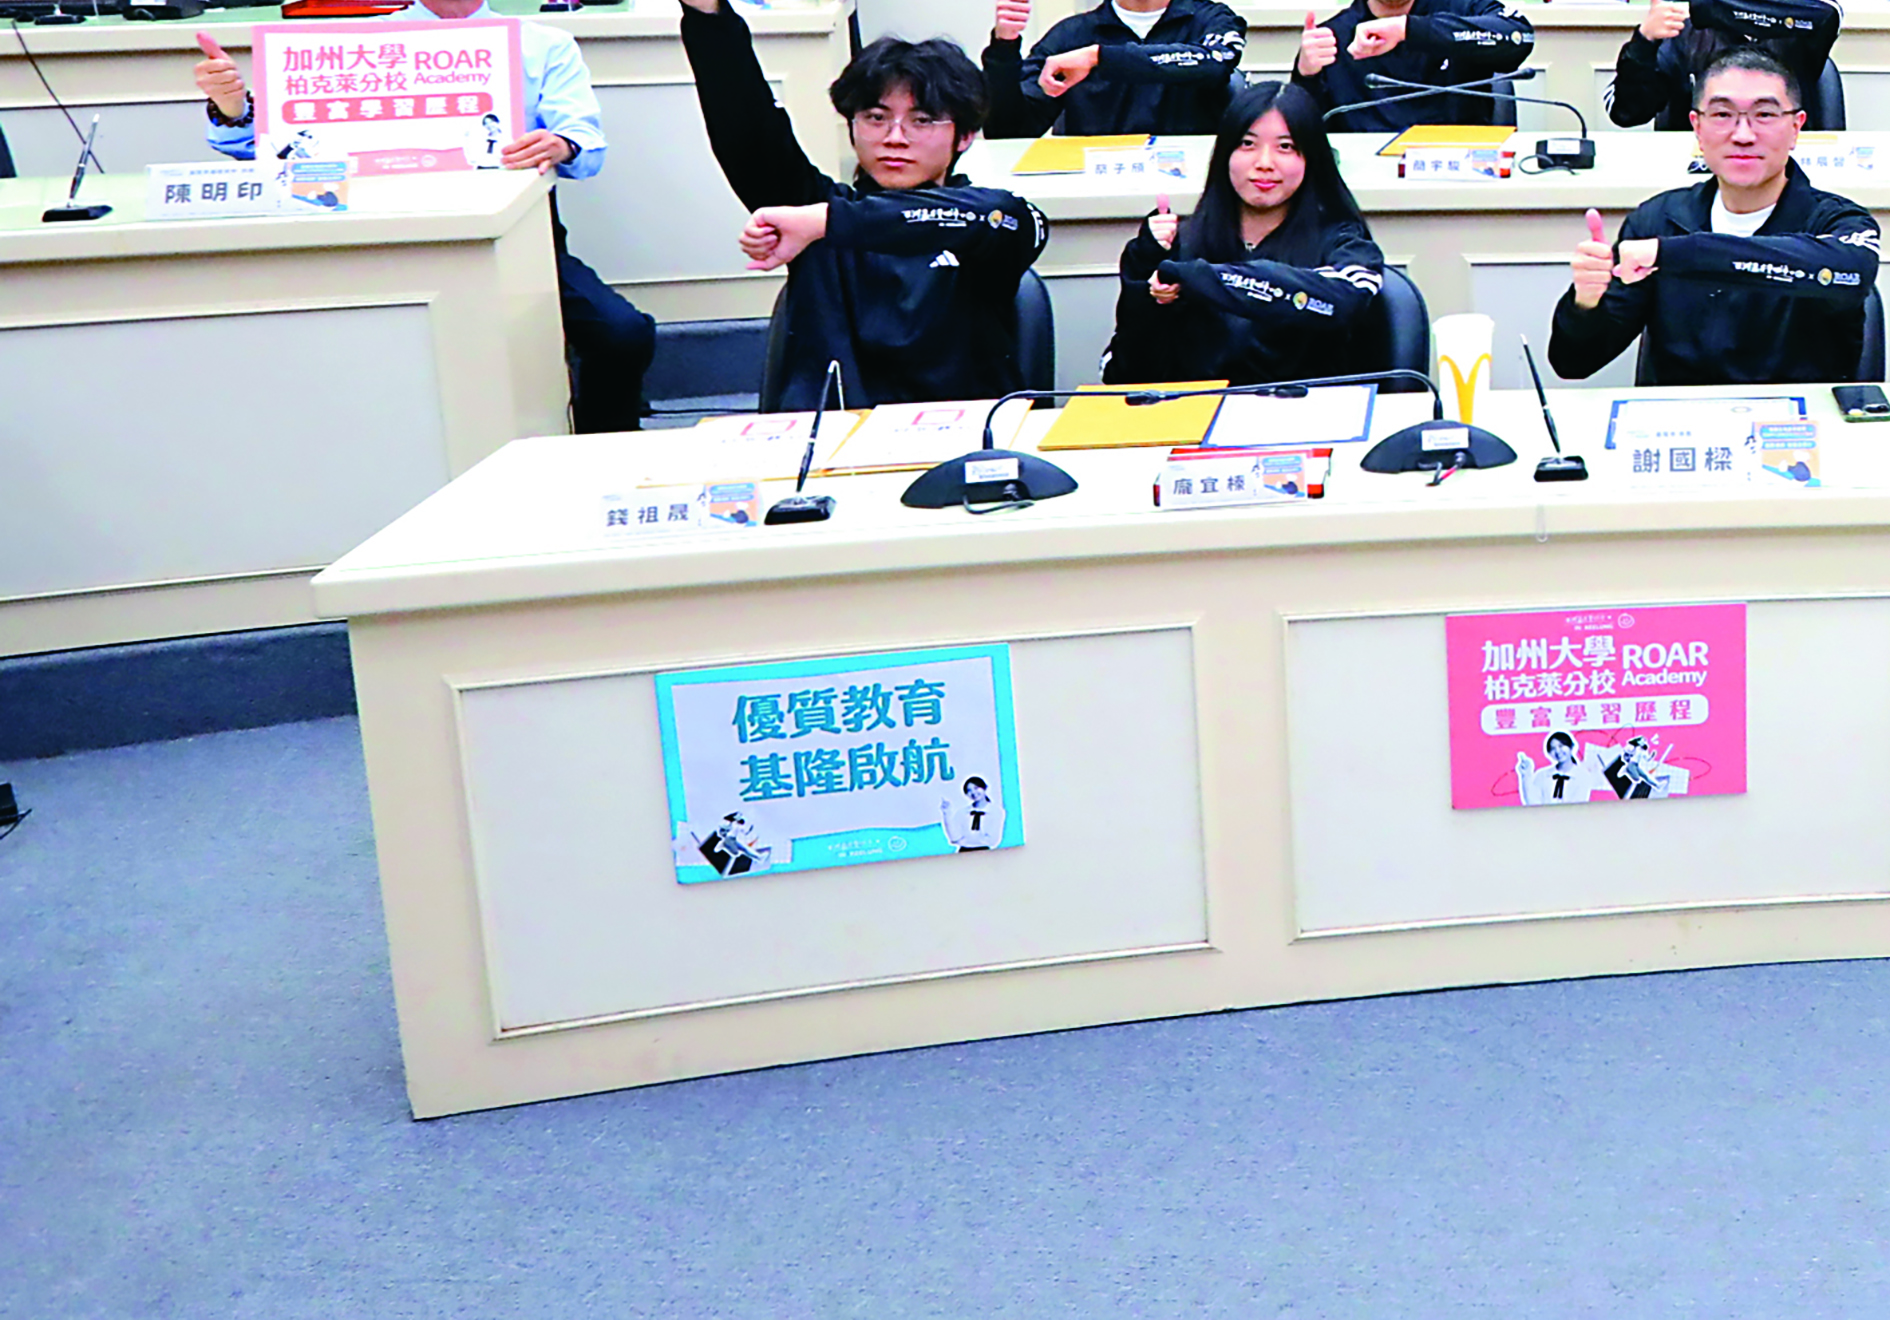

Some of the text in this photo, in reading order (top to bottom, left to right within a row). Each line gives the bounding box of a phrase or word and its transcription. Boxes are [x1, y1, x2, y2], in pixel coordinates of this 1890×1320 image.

[282, 43, 493, 73] 加州大學 ROAR
[284, 71, 492, 96] 柏克萊分校 Academy
[164, 181, 263, 205] 陳明印
[1632, 446, 1733, 473] 謝國樑
[1481, 634, 1710, 673] 加州大學 ROAR
[1483, 668, 1708, 701] 柏克萊分校 Academy
[731, 677, 947, 744] 優質教育
[1494, 699, 1692, 731] 豐富學習歷程
[738, 736, 956, 802] 基隆啟航
